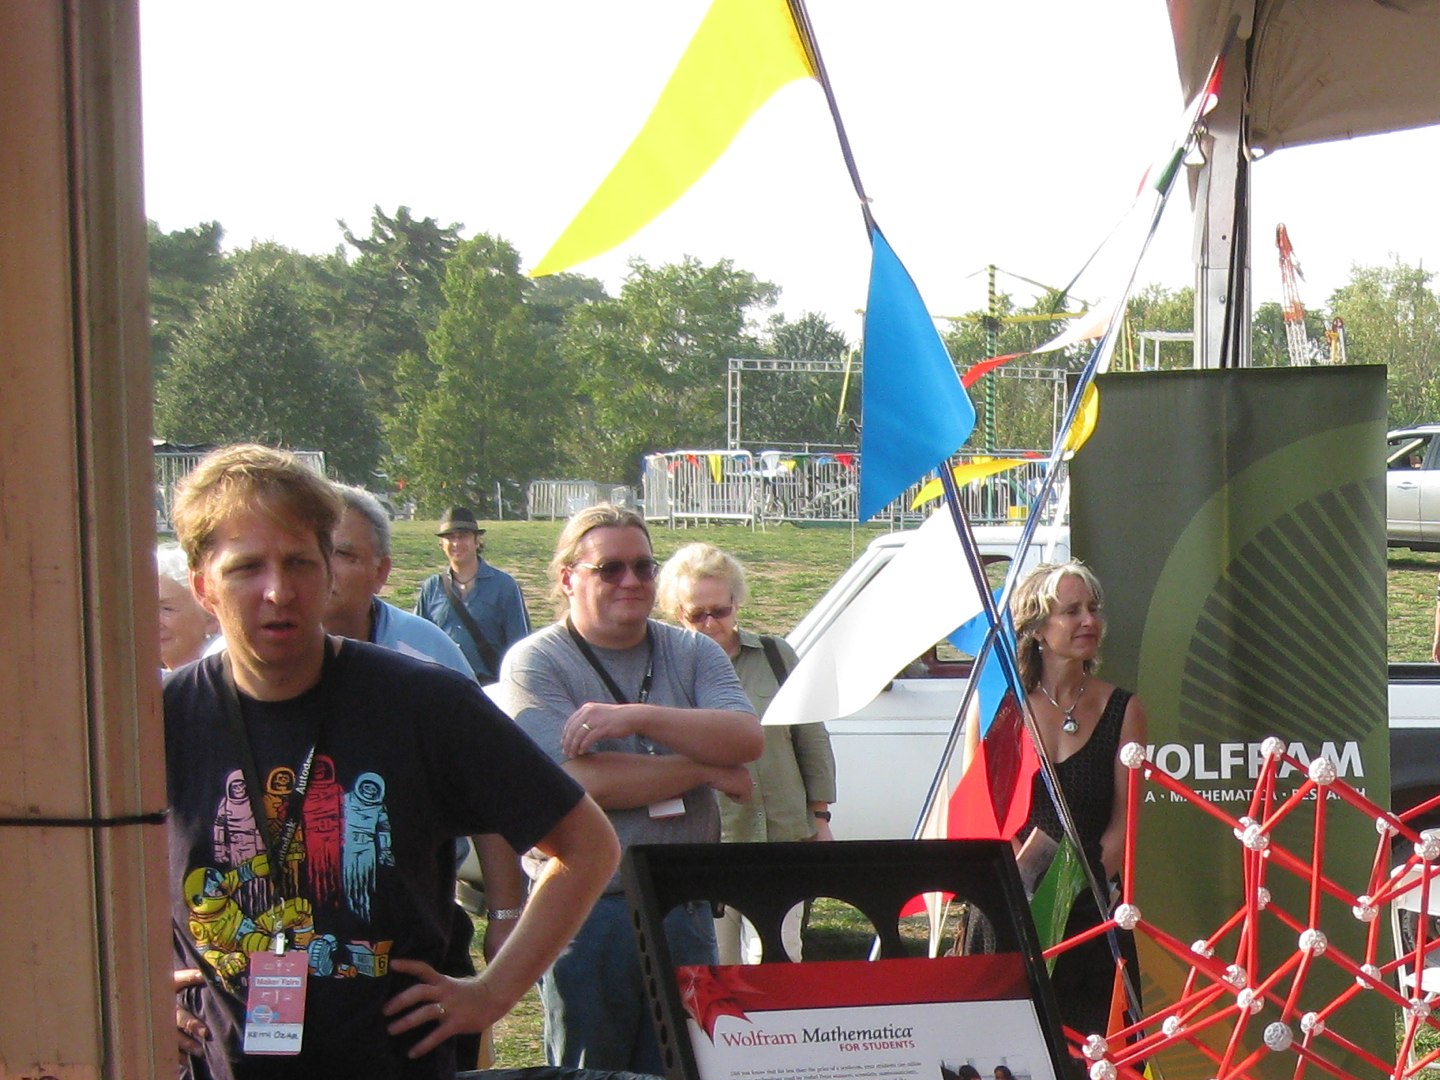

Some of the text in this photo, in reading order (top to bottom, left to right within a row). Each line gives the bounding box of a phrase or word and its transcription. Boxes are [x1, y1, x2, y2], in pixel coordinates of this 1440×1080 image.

[1146, 741, 1365, 780] OLFAM
[1170, 789, 1278, 802] MTHEMAT
[279, 818, 297, 865] utodesk
[722, 1023, 913, 1047] Wolfram Mathematica
[839, 1040, 915, 1052] FOR STUDENTS
